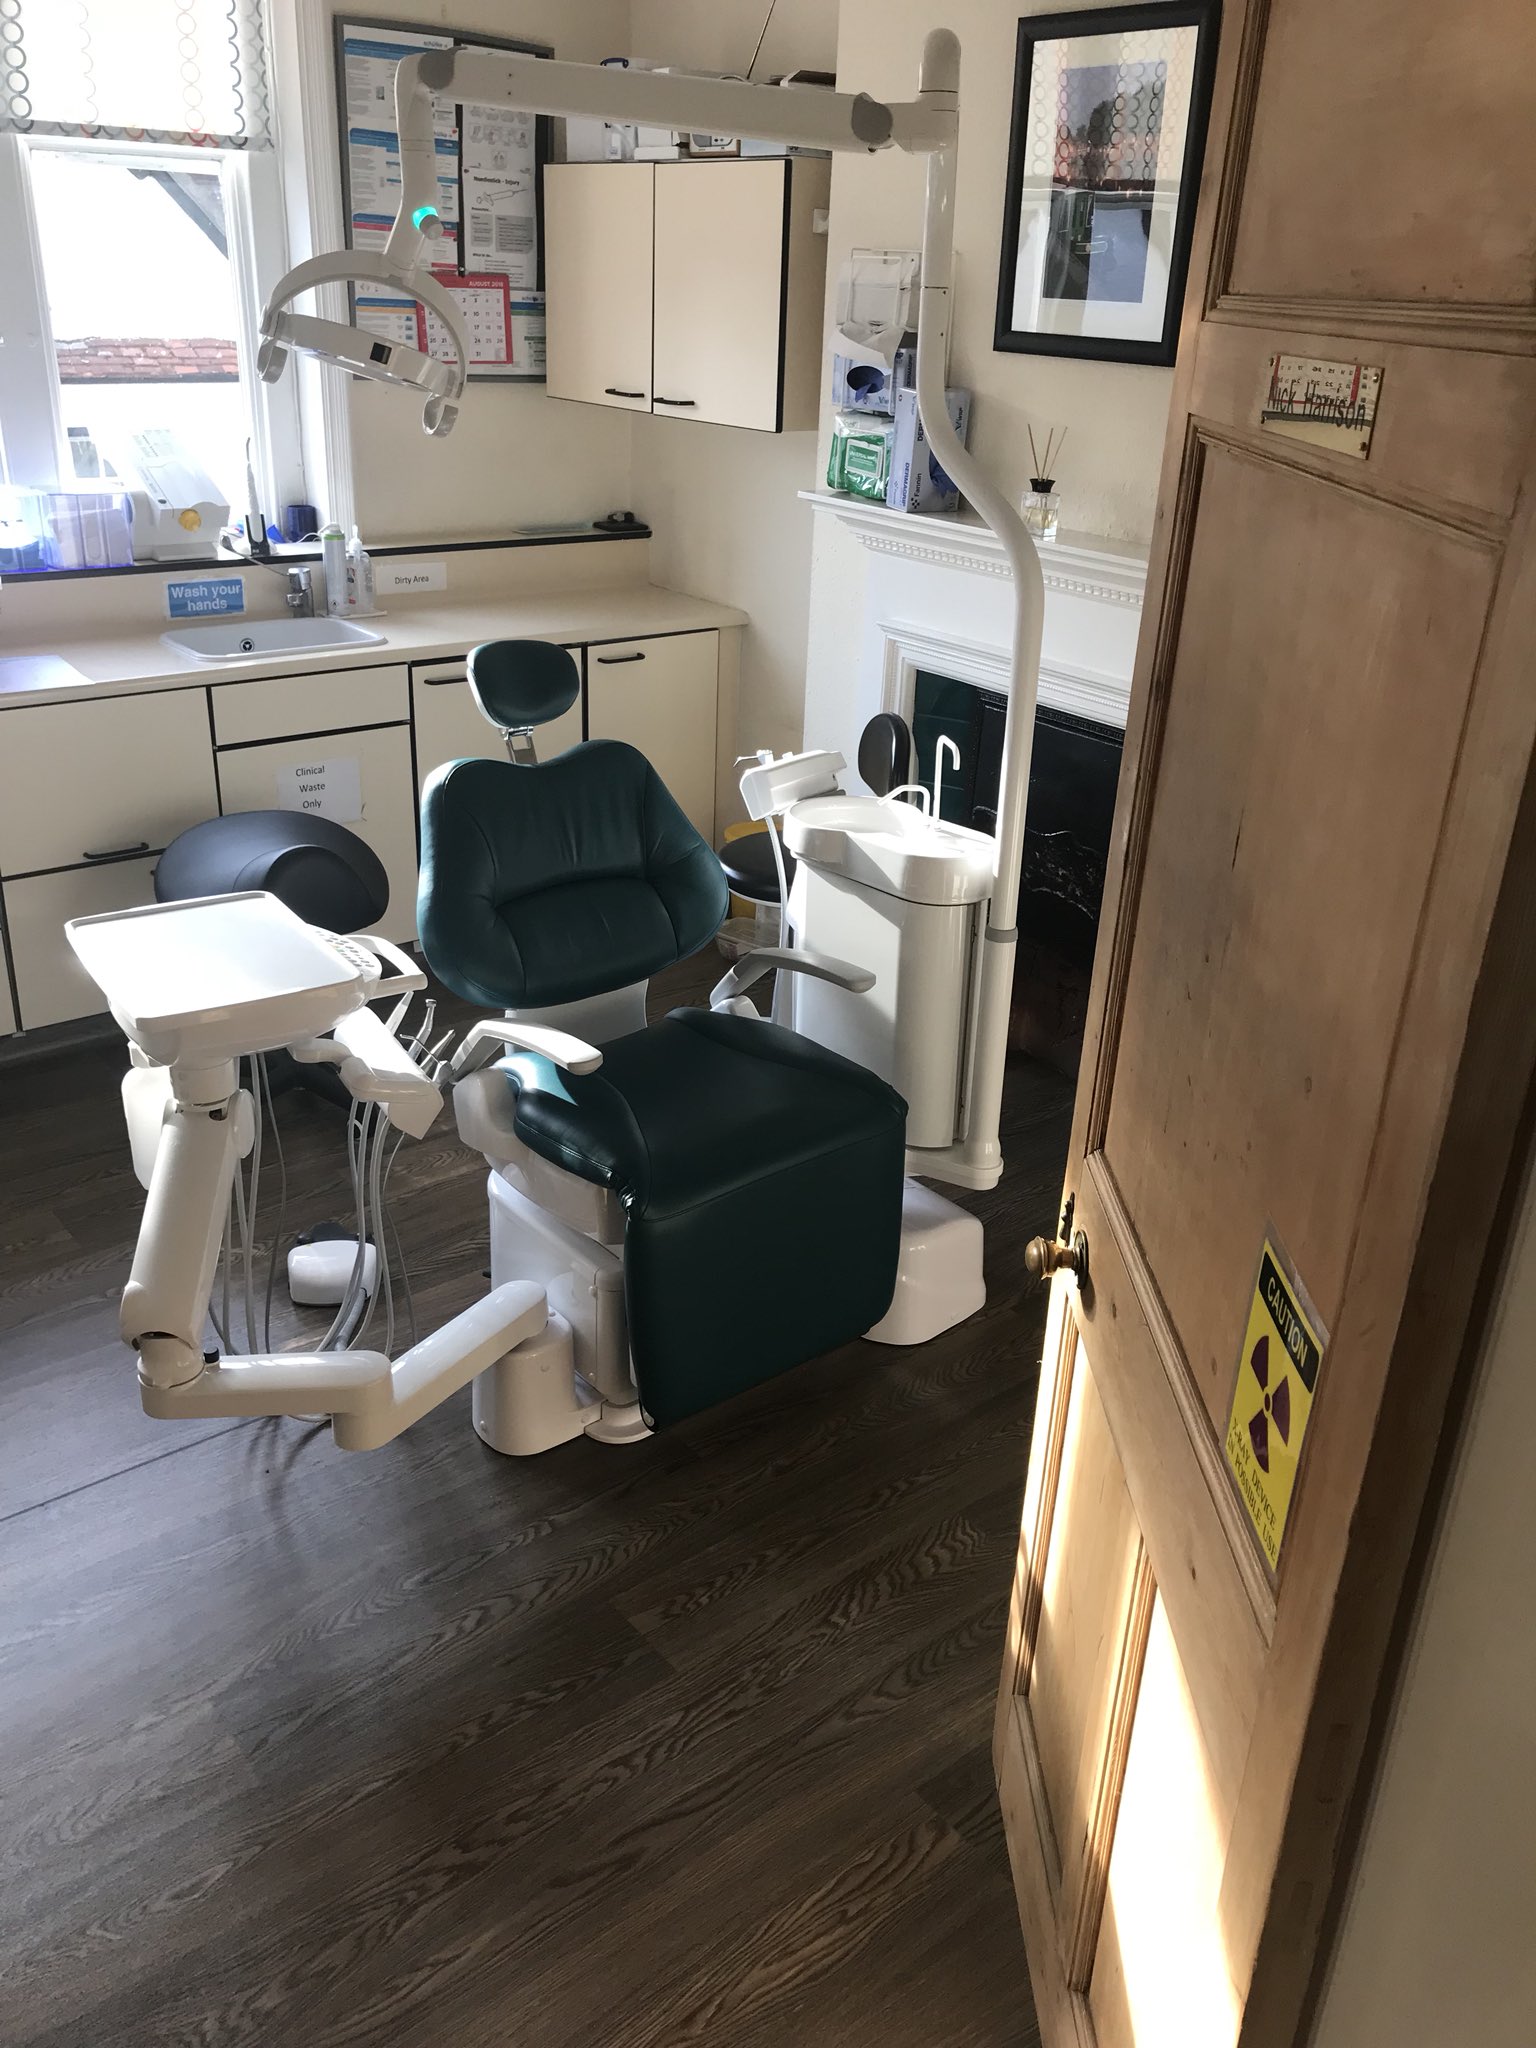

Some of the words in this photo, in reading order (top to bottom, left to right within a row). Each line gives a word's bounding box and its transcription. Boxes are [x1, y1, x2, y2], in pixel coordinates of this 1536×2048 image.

[1267, 375, 1296, 415] Nick
[1303, 381, 1366, 432] Harrison
[902, 462, 910, 507] DERMAGRIP
[914, 473, 922, 497] Fannin
[394, 576, 412, 586] Dirty
[413, 576, 429, 584] Area
[171, 585, 208, 600] Wash
[211, 584, 241, 602] your
[187, 598, 227, 612] hands
[295, 765, 325, 777] Clinical
[299, 783, 326, 793] Waste
[302, 799, 322, 809] Only
[1267, 1276, 1308, 1368] CAUTION
[1233, 1417, 1250, 1466] X-RAY
[1252, 1469, 1276, 1531] DEVICE
[1227, 1432, 1235, 1454] IN
[1235, 1453, 1262, 1526] POSSIBLE
[1263, 1523, 1277, 1562] USE
